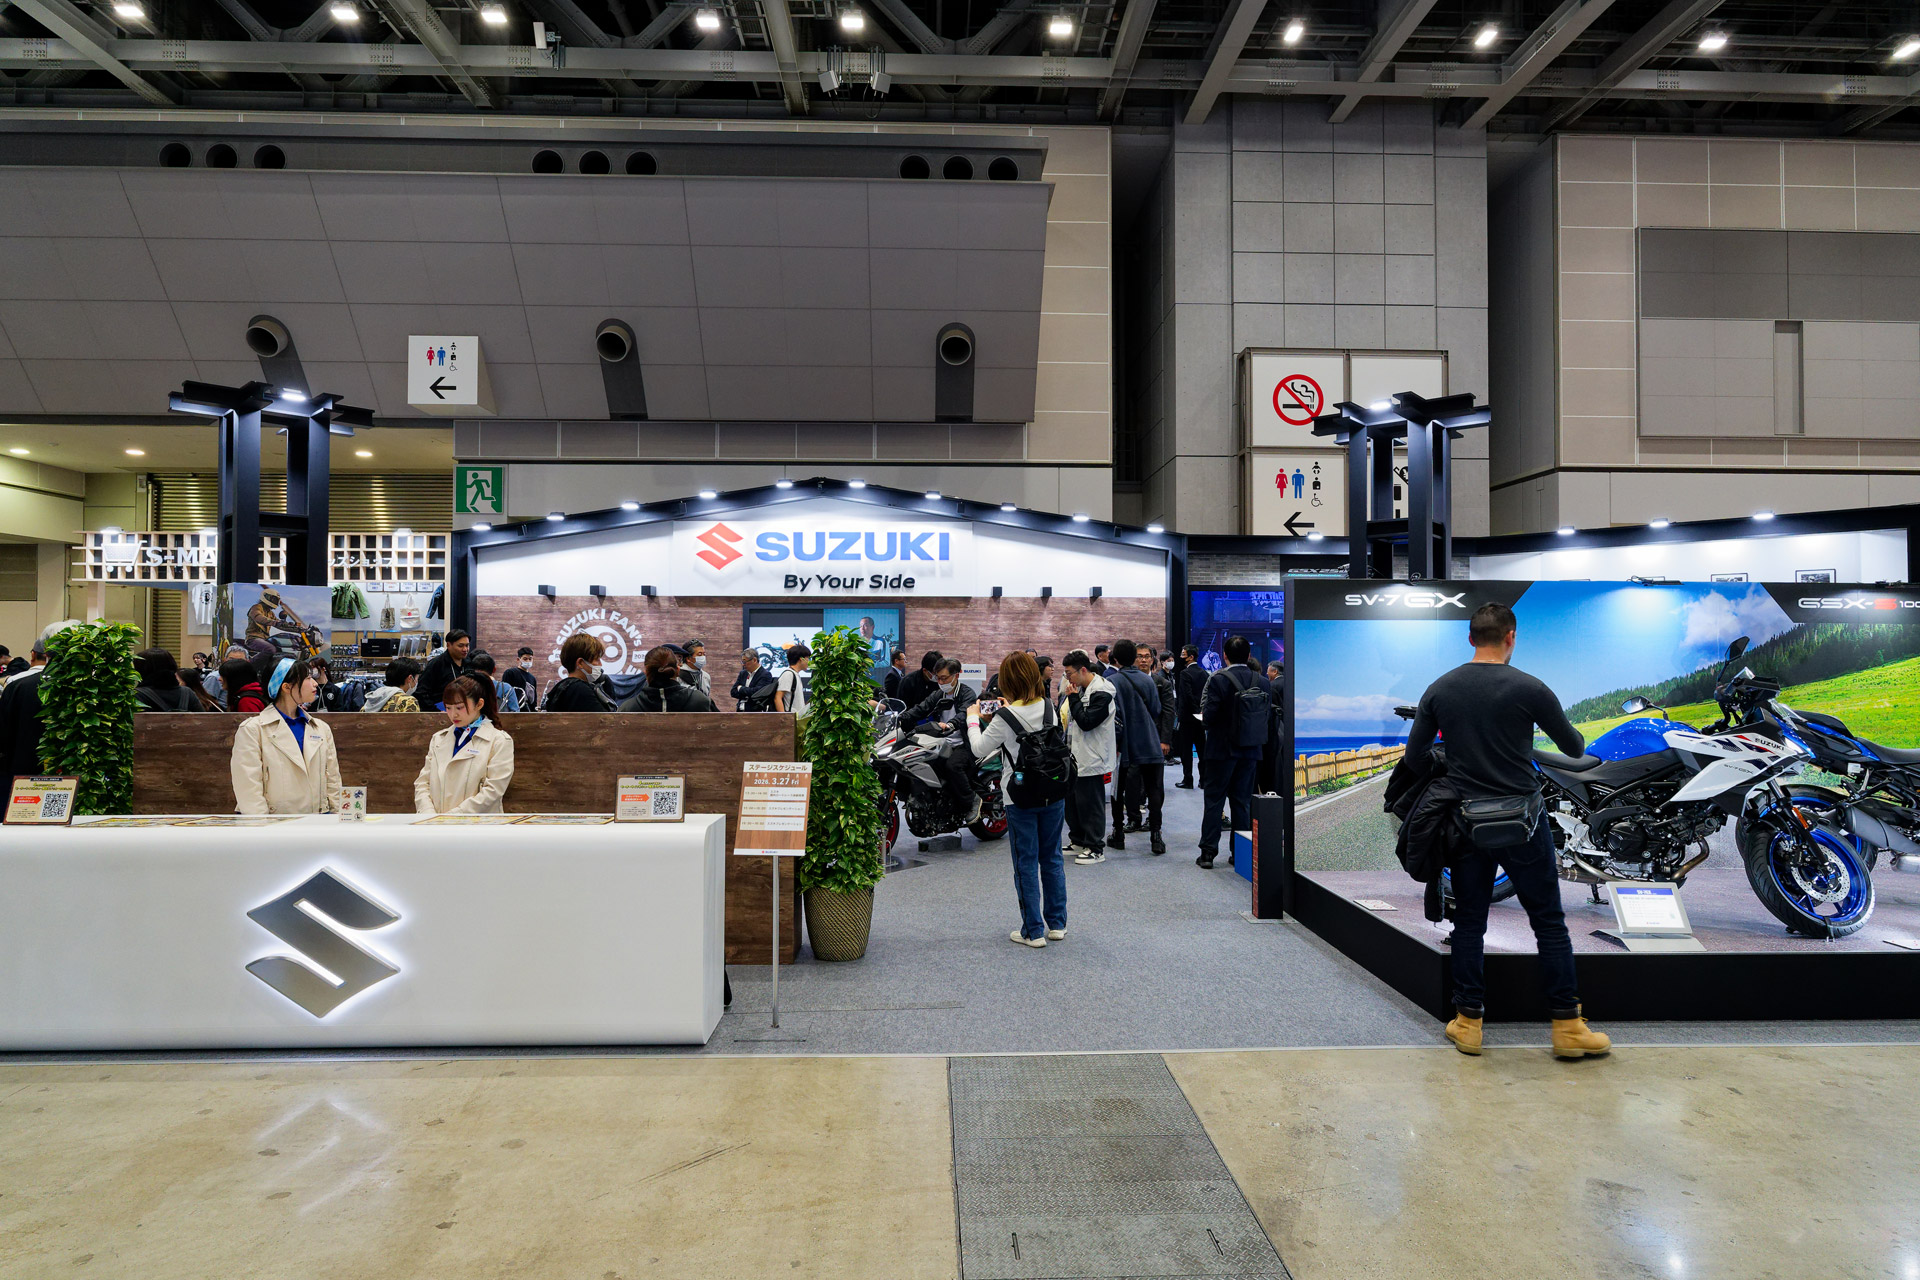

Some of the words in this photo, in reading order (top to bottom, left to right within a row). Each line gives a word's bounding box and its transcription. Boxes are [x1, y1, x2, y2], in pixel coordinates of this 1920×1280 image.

[755, 531, 950, 562] SUZUKI
[146, 546, 218, 567] S-MA
[784, 574, 812, 592] By
[816, 574, 864, 589] Your
[869, 574, 916, 589] Side
[556, 608, 606, 645] SUZUKI
[1754, 738, 1785, 751] SUZUKI
[748, 764, 808, 772] ステージスケジュール
[772, 777, 790, 785] 3.27
